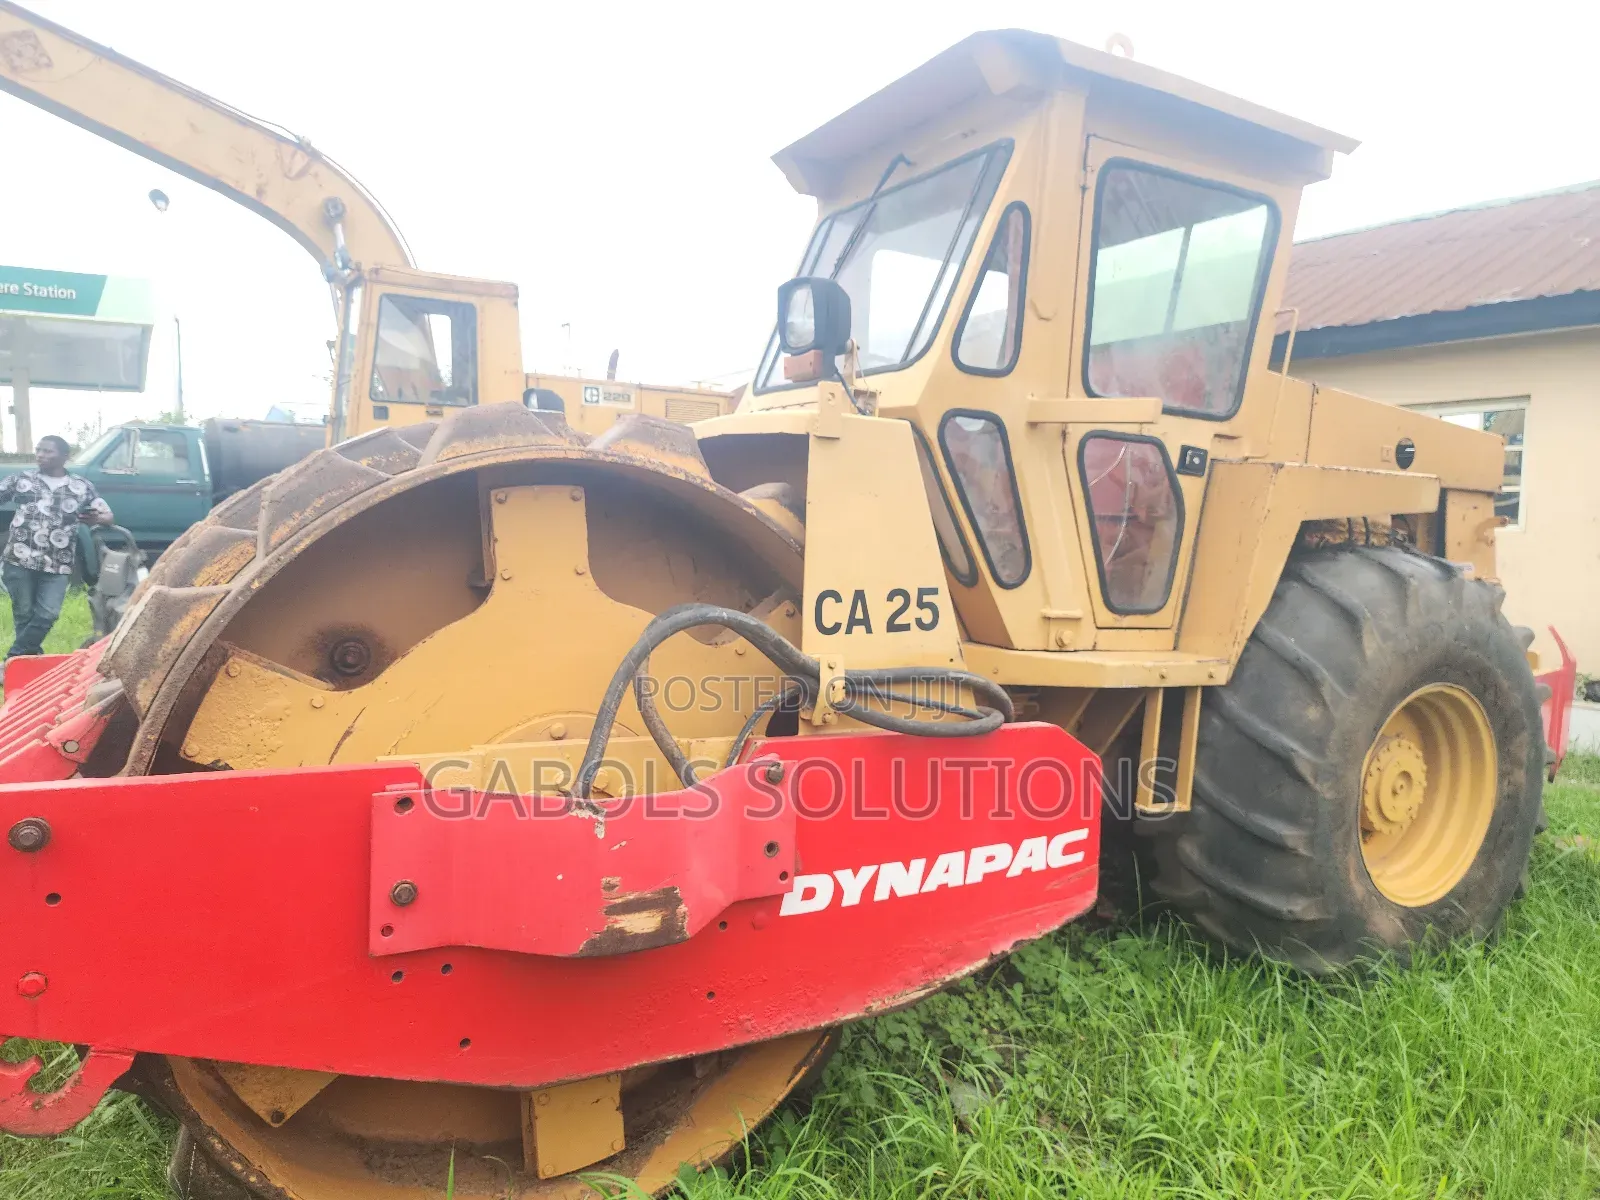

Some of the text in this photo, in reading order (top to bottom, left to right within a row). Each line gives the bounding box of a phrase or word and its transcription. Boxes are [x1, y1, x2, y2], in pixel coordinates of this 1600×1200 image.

[23, 281, 77, 300] Station
[814, 587, 940, 636] CA 25
[779, 828, 1089, 917] DYNAPAC
